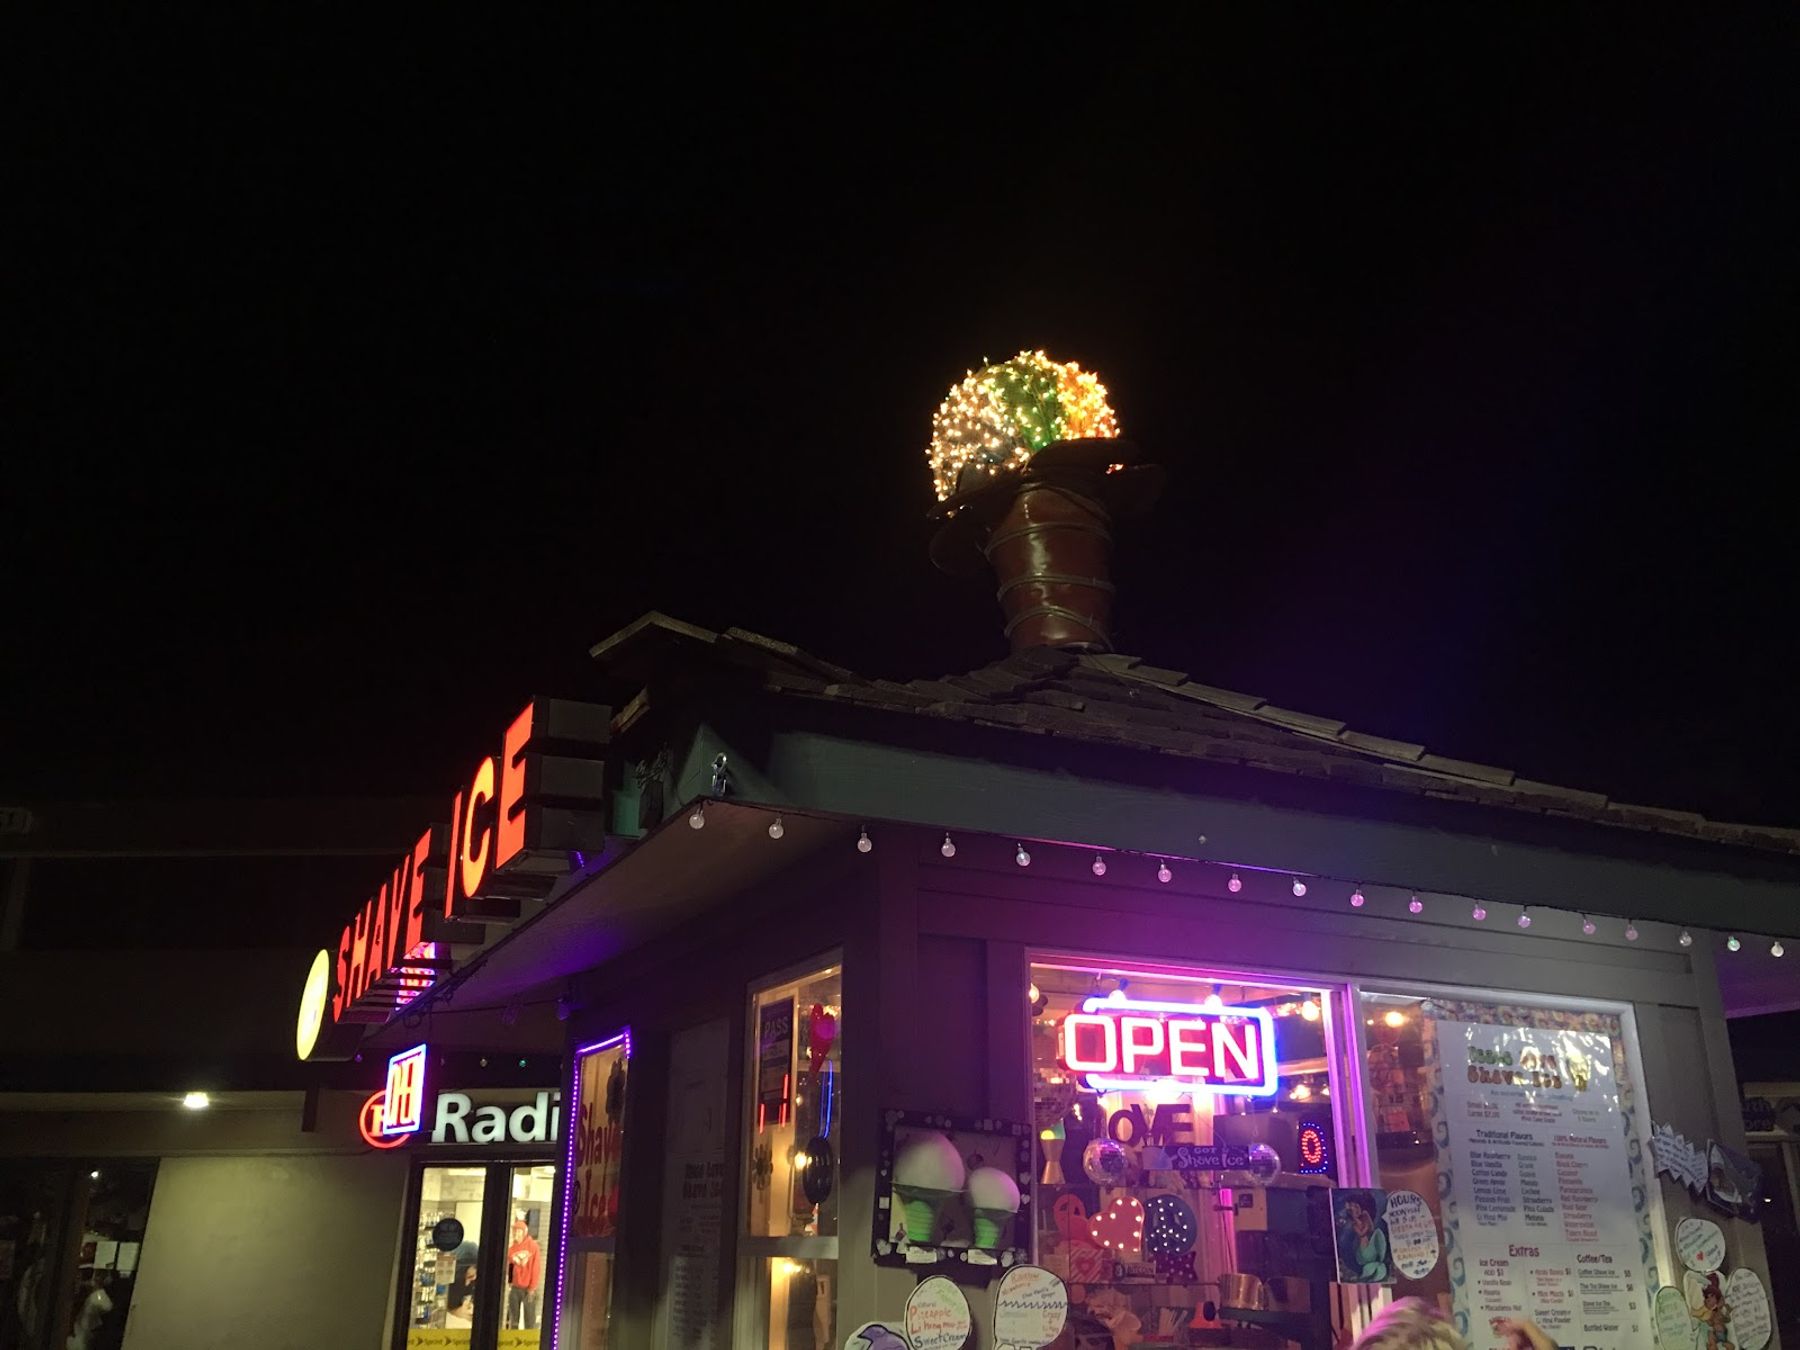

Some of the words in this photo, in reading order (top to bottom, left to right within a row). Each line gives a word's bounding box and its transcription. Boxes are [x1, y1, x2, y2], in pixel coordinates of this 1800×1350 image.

[333, 827, 432, 1023] SHAVE
[445, 702, 534, 919] ICE
[1062, 1013, 1260, 1080] OPEN
[1476, 1129, 1508, 1139] Traditional
[1508, 1244, 1540, 1257] Extras
[1479, 1259, 1488, 1267] Ice
[1489, 1259, 1509, 1267] Cream
[1577, 1254, 1613, 1263] Coffee/Tea
[1584, 1324, 1602, 1332] Bottled
